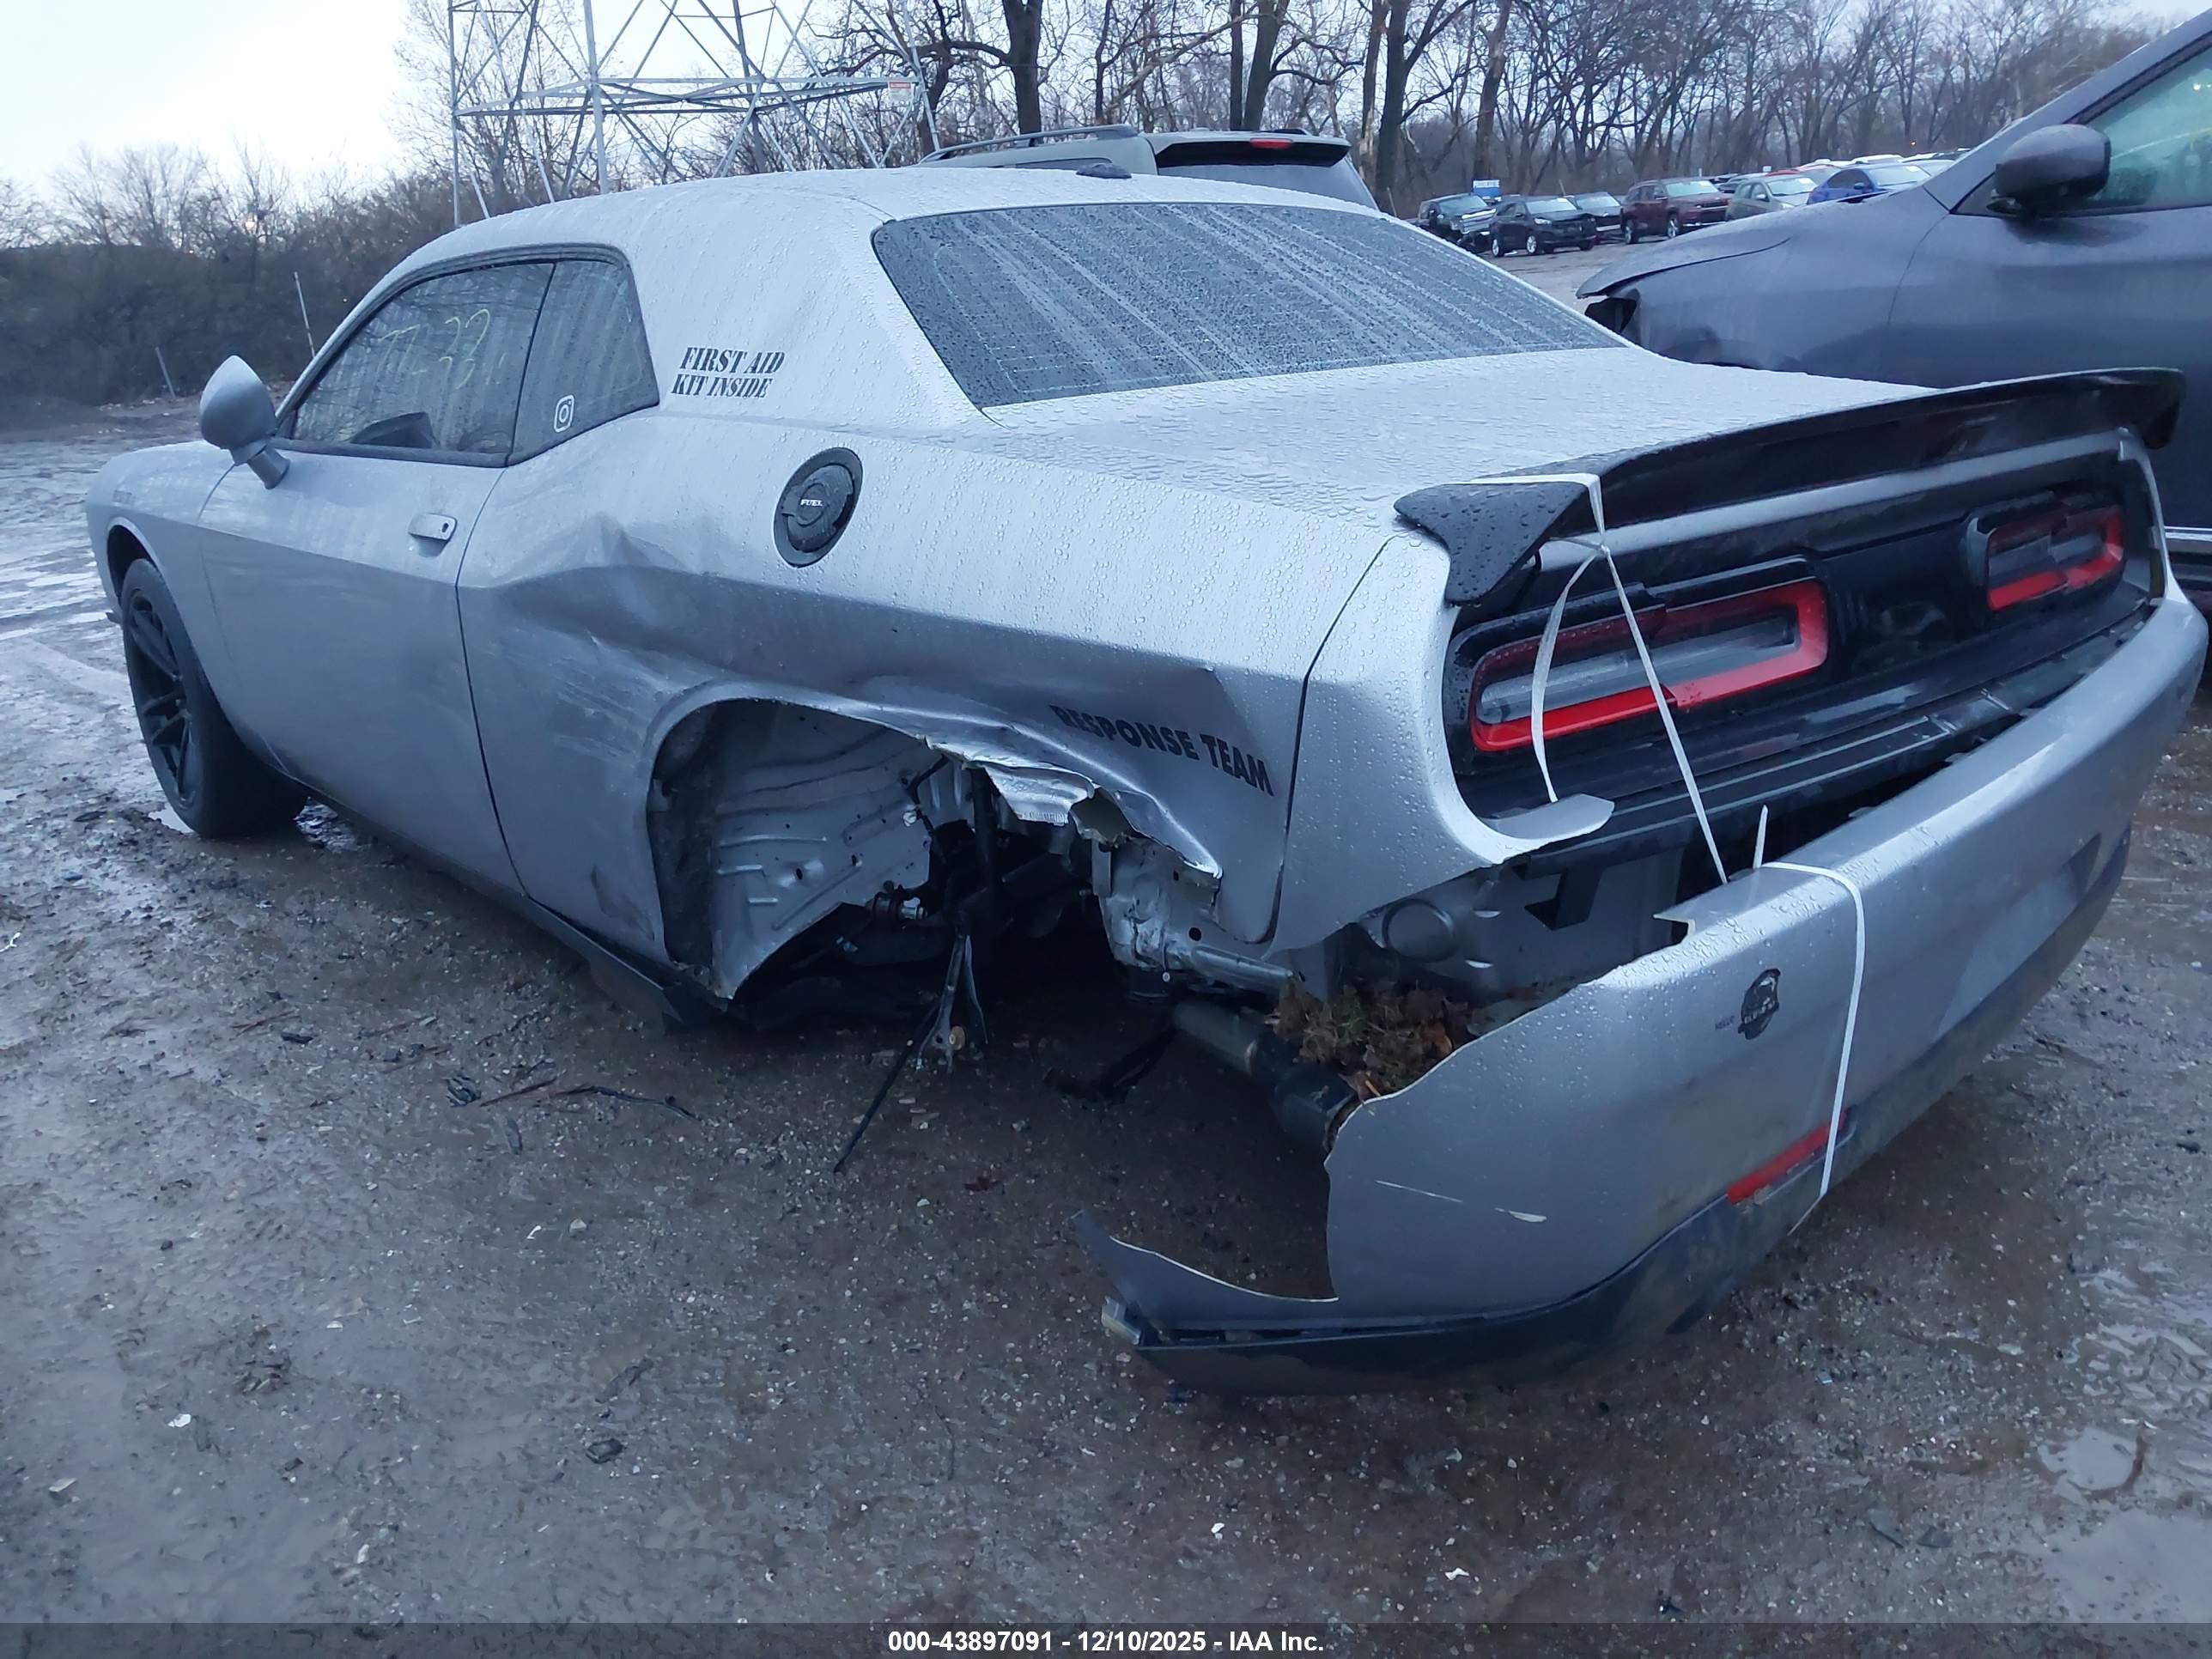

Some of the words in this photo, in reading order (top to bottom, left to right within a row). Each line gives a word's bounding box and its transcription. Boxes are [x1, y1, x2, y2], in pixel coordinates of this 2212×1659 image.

[680, 347, 747, 374] FIRST
[744, 351, 785, 374] AID
[671, 374, 709, 397] KIT
[708, 376, 774, 398] INSIDE
[1048, 704, 1200, 761] RESPONSE
[1200, 733, 1274, 797] TEAM
